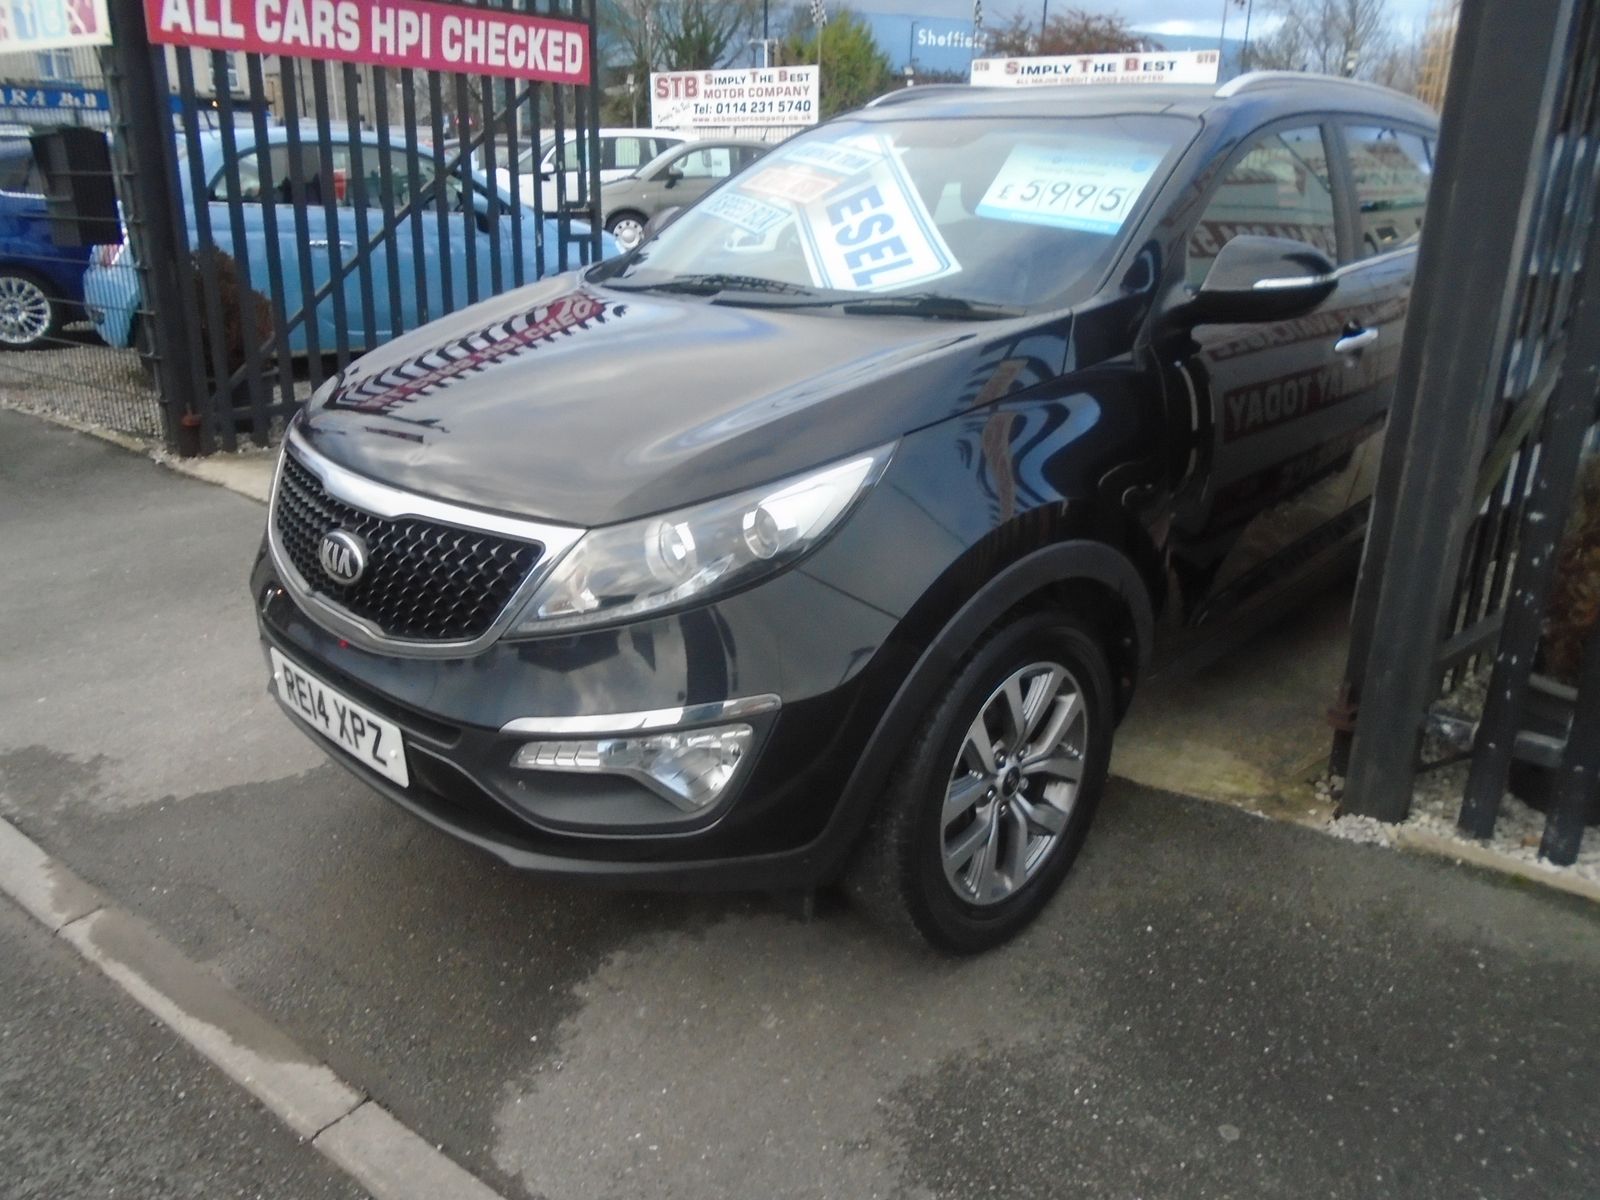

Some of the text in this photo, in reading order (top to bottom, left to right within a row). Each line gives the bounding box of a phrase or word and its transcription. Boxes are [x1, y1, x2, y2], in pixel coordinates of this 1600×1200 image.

[160, 0, 245, 40] ALL
[255, 0, 360, 52] CARS
[371, 6, 431, 59] HPI
[441, 15, 583, 75] CHECKED
[1005, 61, 1072, 75] SIMPLY
[1077, 59, 1117, 73] THE
[1125, 57, 1177, 72] BEST
[656, 69, 811, 100] STB SIMPLY THE BEST
[703, 84, 811, 100] MOTOR COMPANY
[693, 103, 712, 116] Tel:
[715, 102, 747, 115] 0114
[750, 101, 774, 114] 231
[778, 100, 812, 114] 5740
[321, 538, 353, 578] KIA
[282, 662, 389, 767] RE14 XPZ
